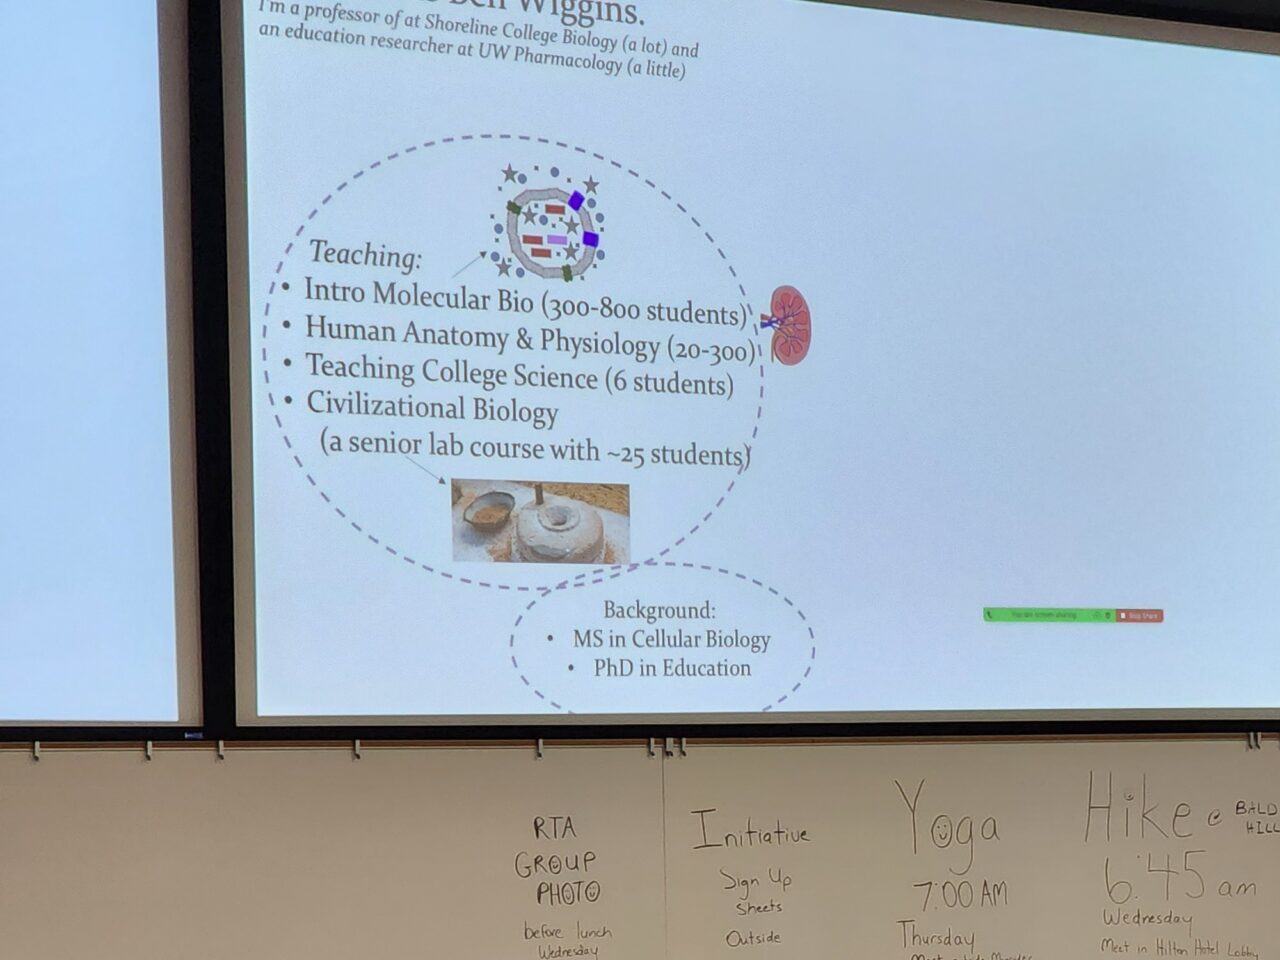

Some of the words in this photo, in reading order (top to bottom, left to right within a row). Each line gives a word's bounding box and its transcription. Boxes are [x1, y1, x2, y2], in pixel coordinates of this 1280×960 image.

[290, 4, 300, 16] a
[304, 3, 381, 25] professor
[384, 10, 404, 30] of
[405, 15, 421, 28] at
[424, 14, 498, 37] Shoreline
[502, 22, 558, 46] College
[562, 30, 618, 54] Biology
[622, 34, 637, 54] (a
[641, 38, 668, 57] lot)
[671, 42, 699, 58] and
[260, 23, 280, 36] an
[285, 23, 366, 46] education
[370, 35, 454, 55] researcher
[457, 43, 474, 57] at
[479, 43, 512, 61] UW
[513, 47, 623, 77] Pharmacology
[627, 57, 643, 76] (a
[646, 60, 686, 82] little)
[310, 239, 422, 275] Teaching:
[304, 276, 366, 303] Intro
[373, 281, 491, 311] Molecular
[497, 288, 535, 314] Bio
[541, 289, 641, 321] (300-800
[646, 300, 748, 330] students)
[305, 315, 398, 342] Human
[402, 320, 510, 355] Anatomy
[516, 327, 534, 351] &
[540, 328, 661, 364] Physiology
[667, 334, 756, 367] (20-300)
[305, 352, 416, 388] Teaching
[422, 359, 508, 392] College
[513, 363, 599, 391] Science
[605, 366, 628, 396] (6
[633, 371, 734, 401] students)
[307, 389, 466, 420] Civilizational
[473, 397, 559, 430] Biology
[320, 426, 343, 456] (a
[348, 430, 423, 455] senior
[429, 431, 464, 457] lab
[469, 440, 545, 460] course
[549, 438, 600, 462] with
[606, 446, 646, 469] ~25
[650, 442, 751, 472] students)
[603, 599, 717, 624] Background:
[573, 629, 604, 648] MS
[609, 629, 626, 648] in
[632, 629, 702, 648] Cellular
[706, 630, 771, 653] Biology
[594, 658, 634, 677] PhD
[640, 658, 657, 677] in
[663, 657, 752, 677] Education
[1084, 771, 1194, 842] Hike
[1235, 800, 1278, 816] BALD
[533, 816, 577, 839] RTA
[690, 808, 811, 850] Initiative
[894, 777, 1001, 876] Yoga
[1246, 820, 1280, 834] HILL
[515, 851, 597, 878] GROUP
[536, 880, 600, 905] PHOTO
[719, 868, 760, 900] Sign
[768, 868, 792, 888] Up
[912, 880, 974, 912] 7:00
[981, 879, 1008, 907] AM
[1217, 880, 1257, 897] am
[524, 921, 564, 940] before
[576, 920, 613, 939] lunch
[726, 930, 782, 948] Outside
[897, 919, 975, 954] Thursday
[1103, 909, 1193, 937] Wednesday
[1101, 937, 1130, 953] Meet
